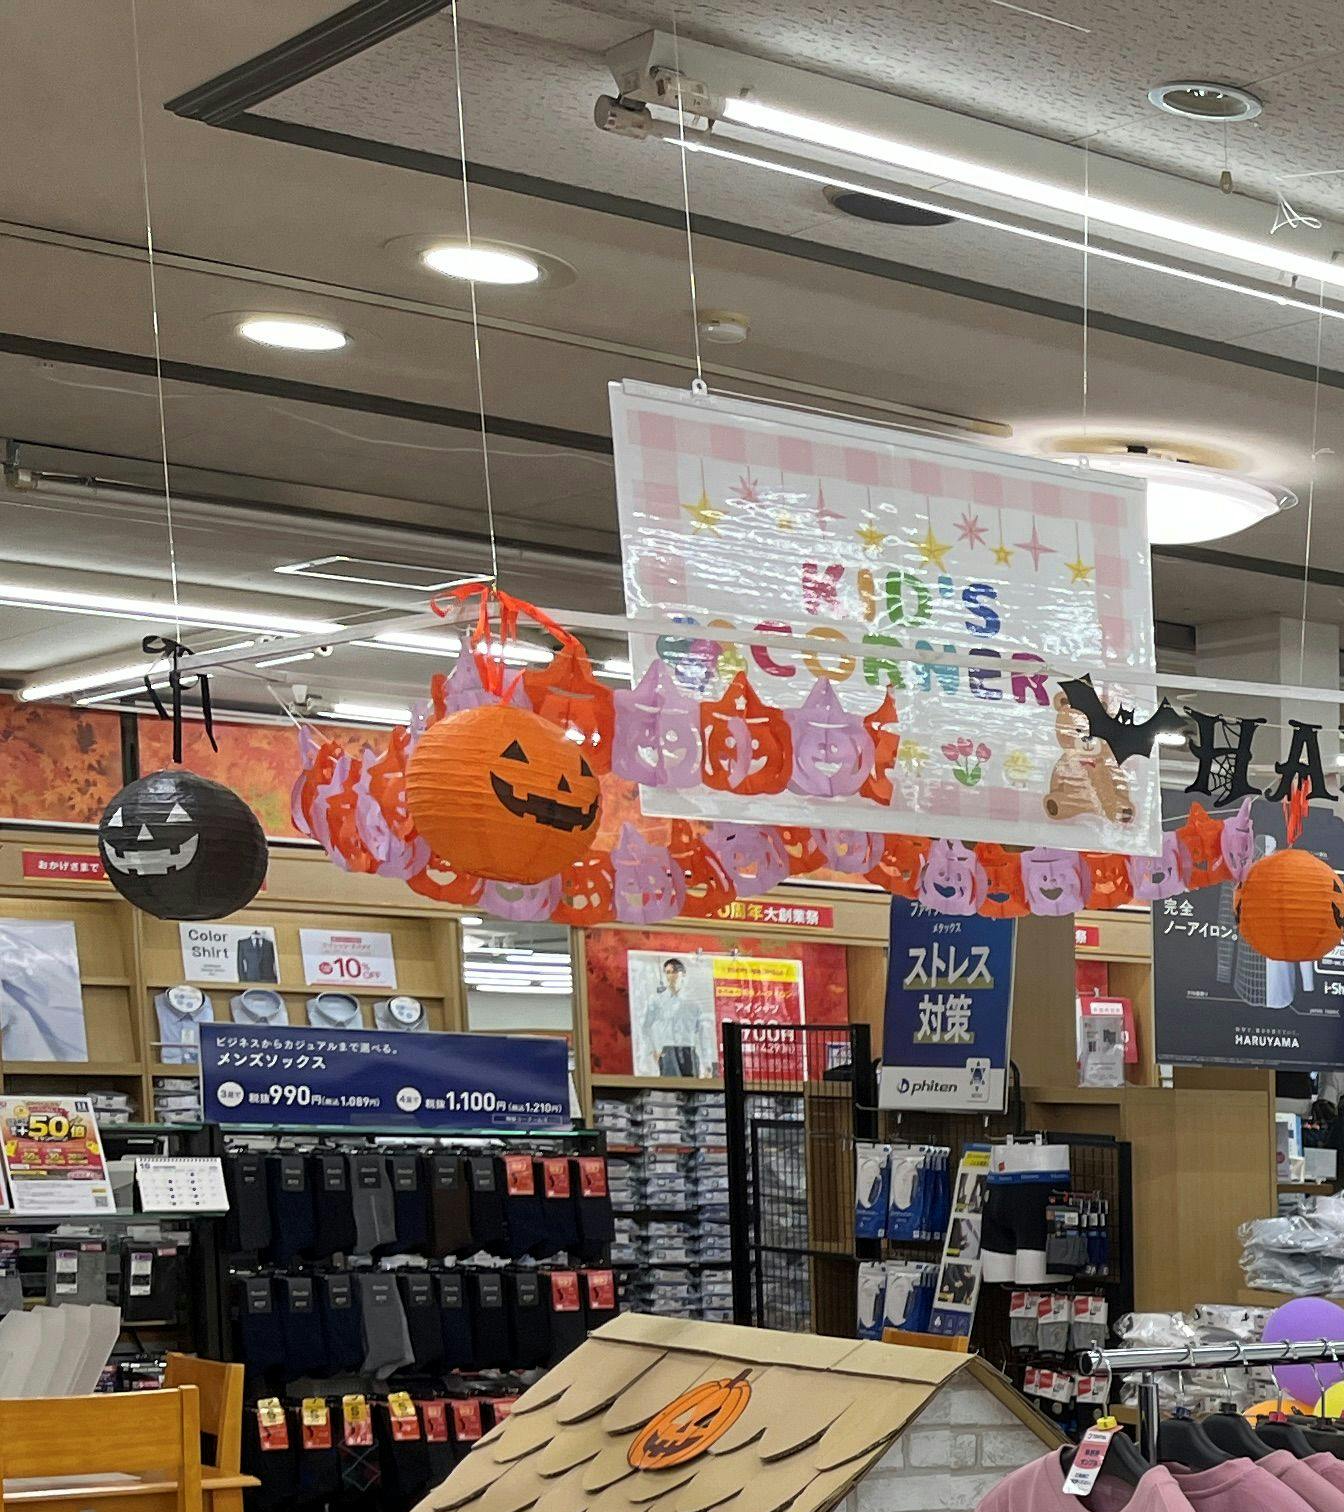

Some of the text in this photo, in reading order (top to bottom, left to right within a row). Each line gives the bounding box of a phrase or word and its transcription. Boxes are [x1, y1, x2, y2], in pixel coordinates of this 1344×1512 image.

[802, 561, 1000, 638] KID'S
[752, 620, 1051, 706] CORNER
[1163, 899, 1195, 917] 完全
[188, 929, 229, 943] Color
[1163, 920, 1239, 941] ノーアイロン。
[191, 946, 229, 959] Shirt
[903, 942, 993, 987] ストレス
[917, 993, 972, 1043] 対策
[1234, 1034, 1300, 1048] HARUYAMA
[217, 1053, 327, 1070] メンズソックス
[911, 1079, 958, 1095] phiten
